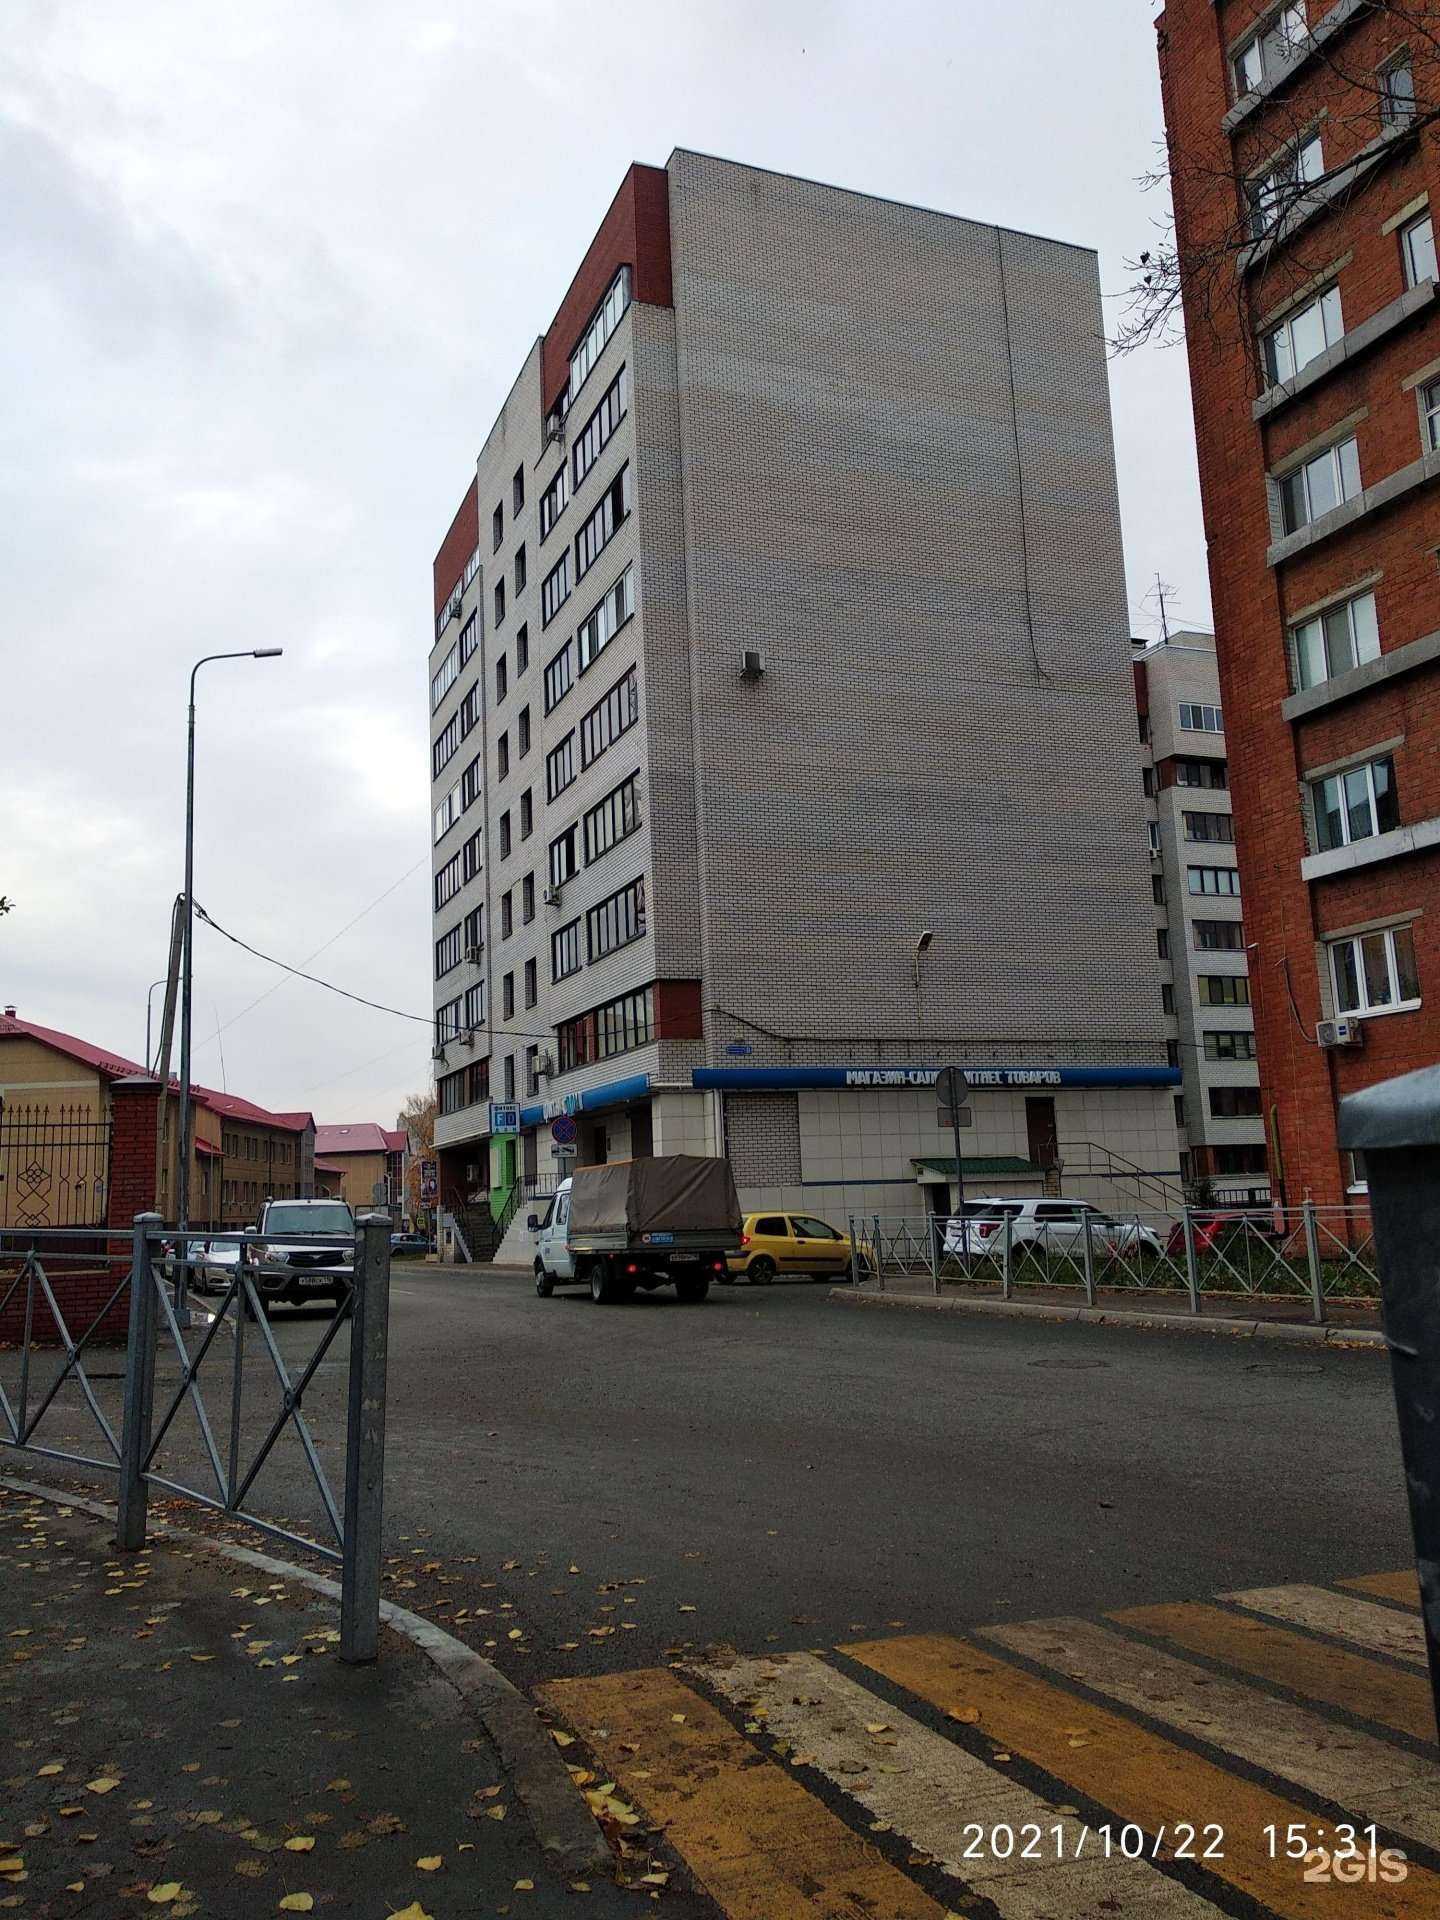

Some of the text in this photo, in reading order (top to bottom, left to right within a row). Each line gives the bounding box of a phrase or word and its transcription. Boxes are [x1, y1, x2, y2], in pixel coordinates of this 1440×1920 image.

[846, 1070, 1062, 1085] МАГАЗИН-САЛ ИТНЕС ТОВАРОВ
